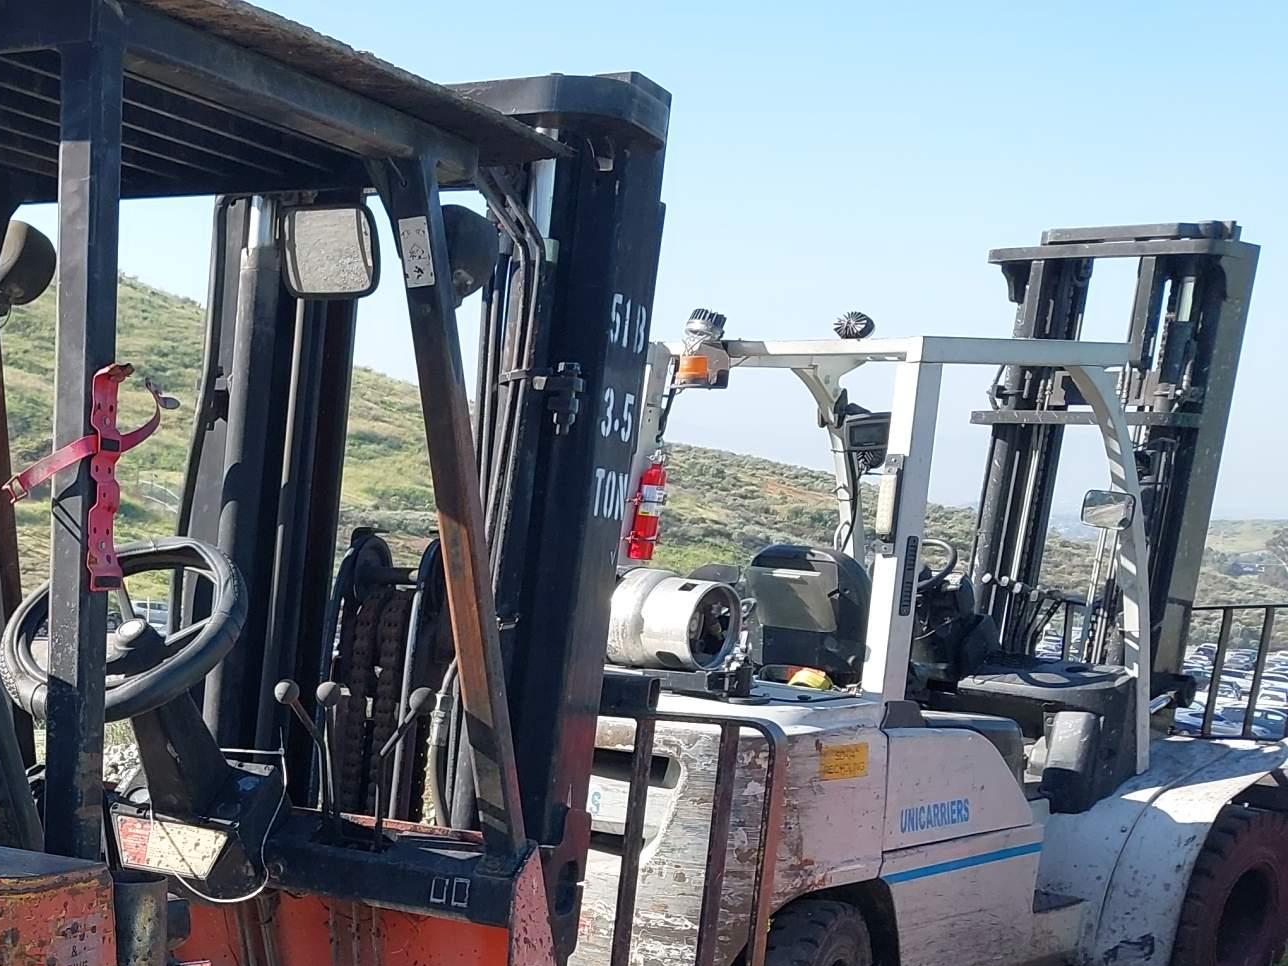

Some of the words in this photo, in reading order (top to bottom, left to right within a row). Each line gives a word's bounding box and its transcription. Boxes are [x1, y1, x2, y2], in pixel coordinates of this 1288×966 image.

[609, 292, 647, 354] 51B
[600, 387, 635, 443] 3.5
[593, 467, 629, 521] TON
[899, 798, 970, 833] UNICARRIERS
